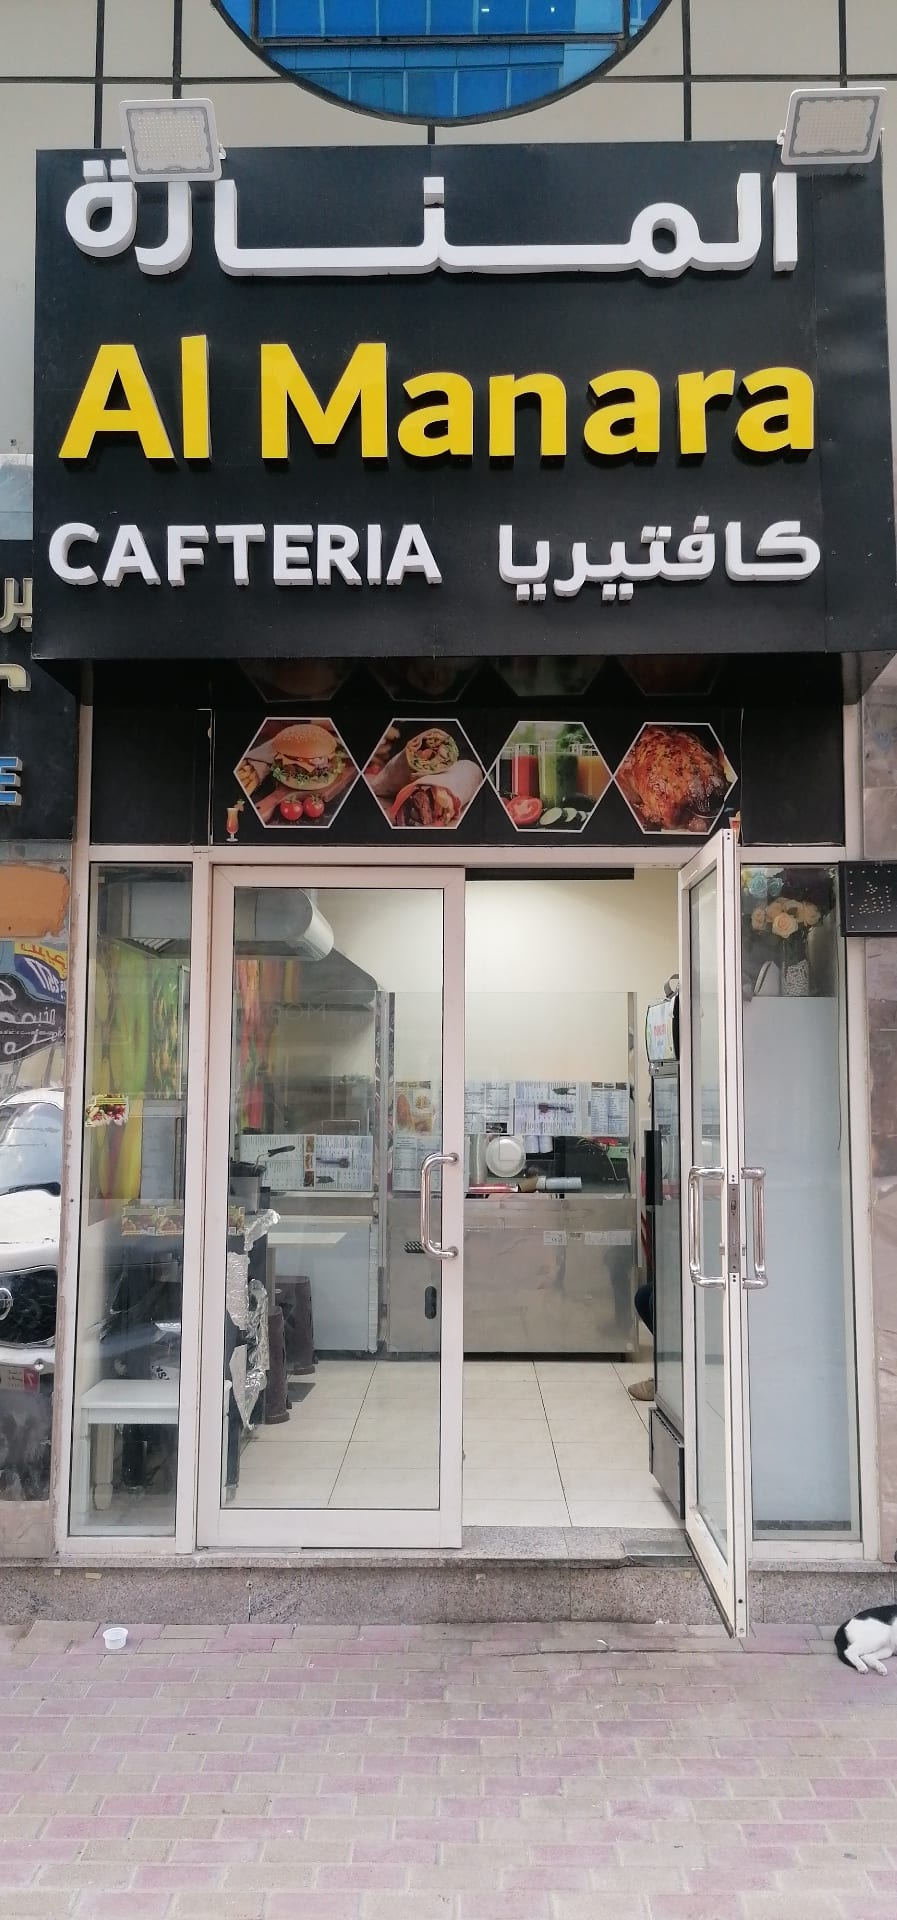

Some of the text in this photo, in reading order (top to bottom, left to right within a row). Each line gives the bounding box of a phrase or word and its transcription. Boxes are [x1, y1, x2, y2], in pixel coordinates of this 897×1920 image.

[64, 158, 799, 277] المنارة
[58, 333, 816, 464] Al Manara
[48, 521, 442, 588] CAFTERIA
[497, 514, 822, 603] كافتيريا
